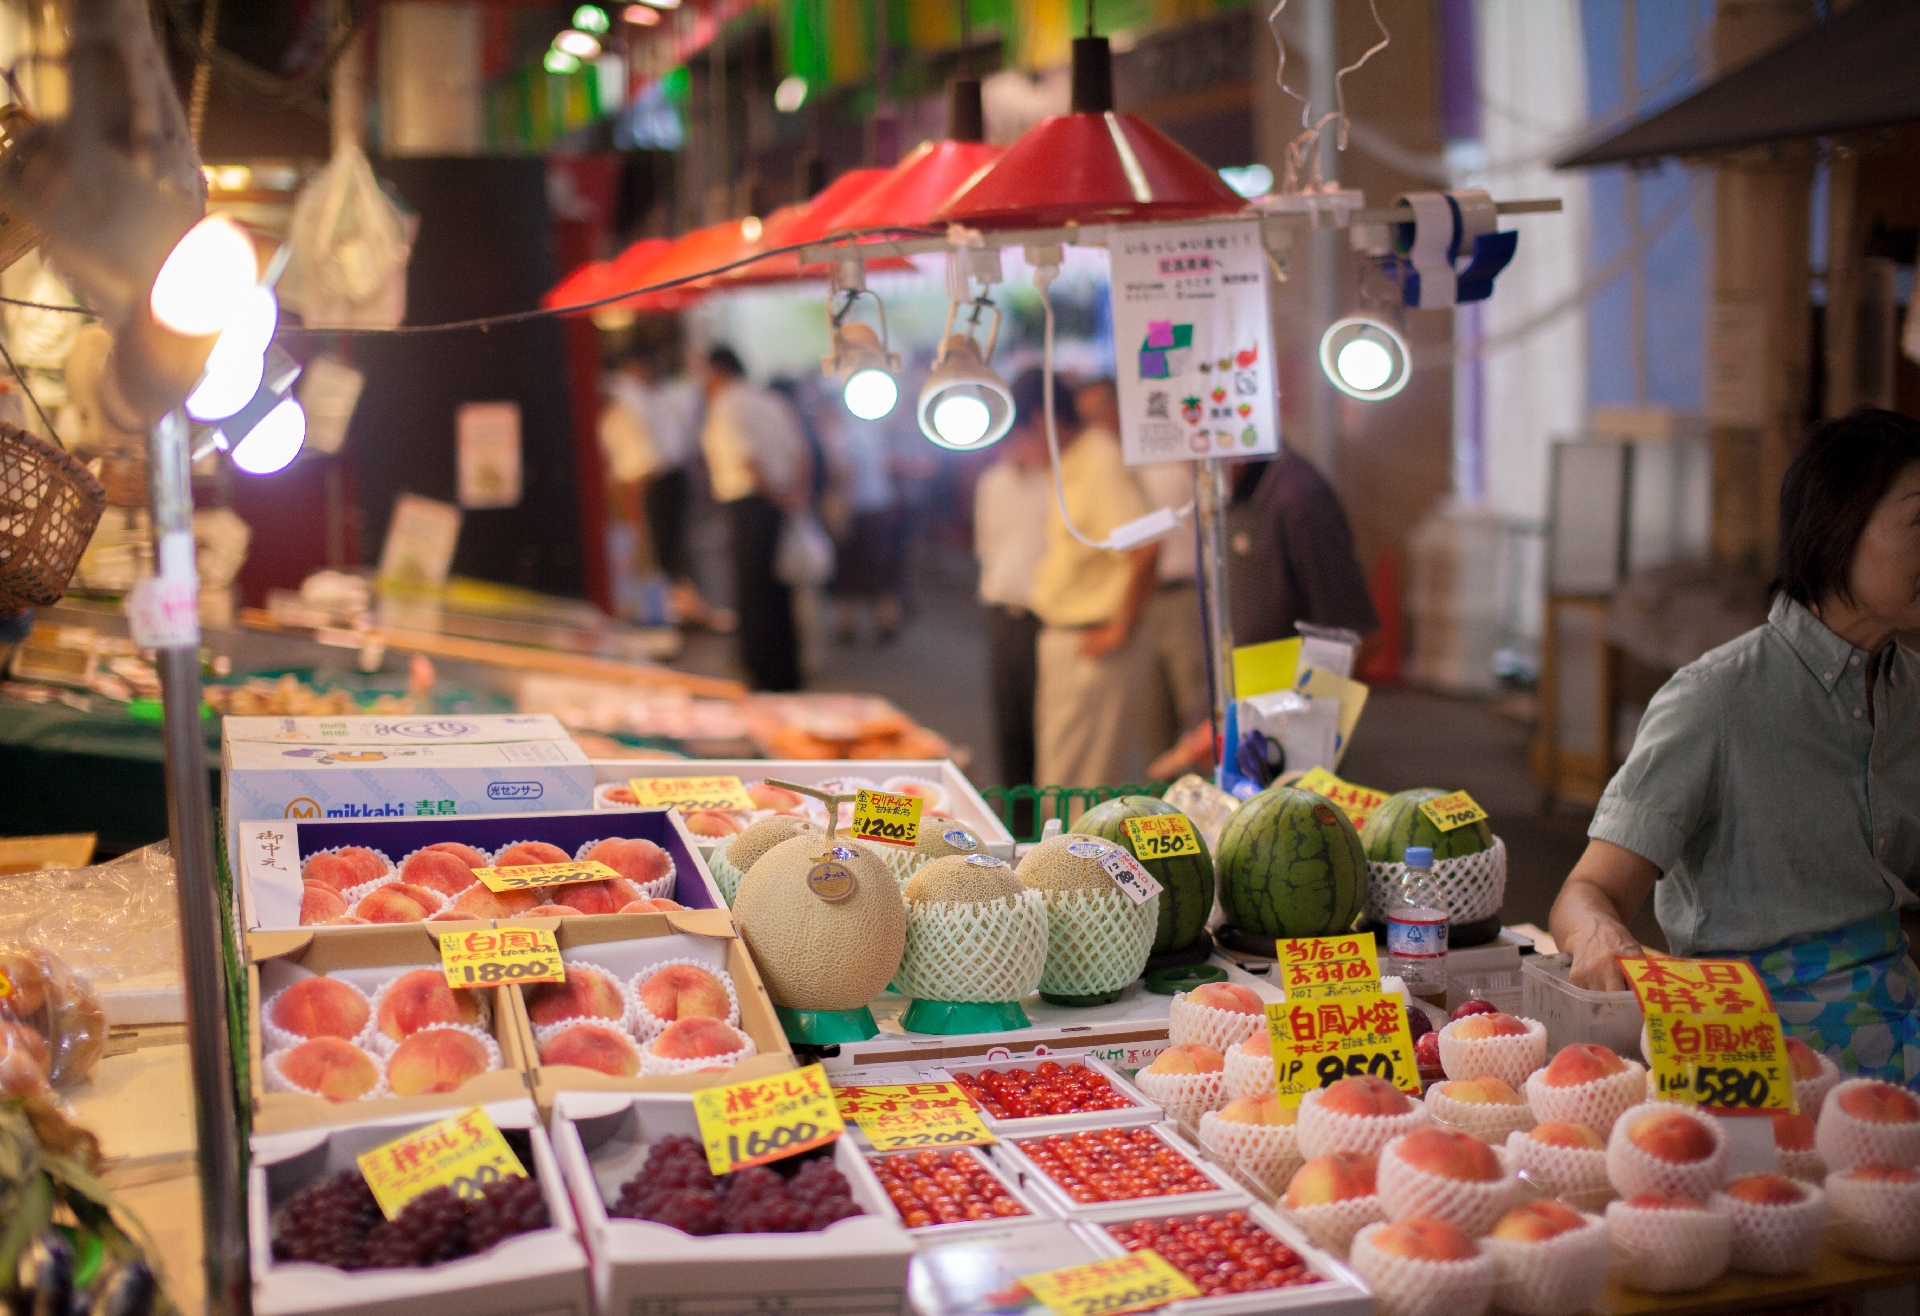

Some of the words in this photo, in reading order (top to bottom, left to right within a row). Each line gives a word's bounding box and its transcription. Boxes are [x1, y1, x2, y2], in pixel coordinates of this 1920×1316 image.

[490, 786, 541, 797] 光センサー
[327, 803, 405, 818] mikkabi
[1445, 810, 1476, 825] 700
[861, 817, 905, 838] 1200
[905, 822, 916, 840] エン
[255, 830, 288, 871] 御中元
[1147, 835, 1185, 854] 750
[501, 872, 595, 888] 3500
[464, 931, 548, 953] 白鳳
[1285, 938, 1360, 963] 当店の
[463, 960, 550, 983] 1800
[1289, 960, 1372, 986] おすすめ
[1268, 1004, 1293, 1041] 山梨
[1287, 1041, 1340, 1057] サービス
[1695, 1065, 1769, 1107] 580
[729, 1122, 819, 1162] 1600
[885, 1131, 977, 1146] 2200
[1071, 1283, 1171, 1314] 2000
